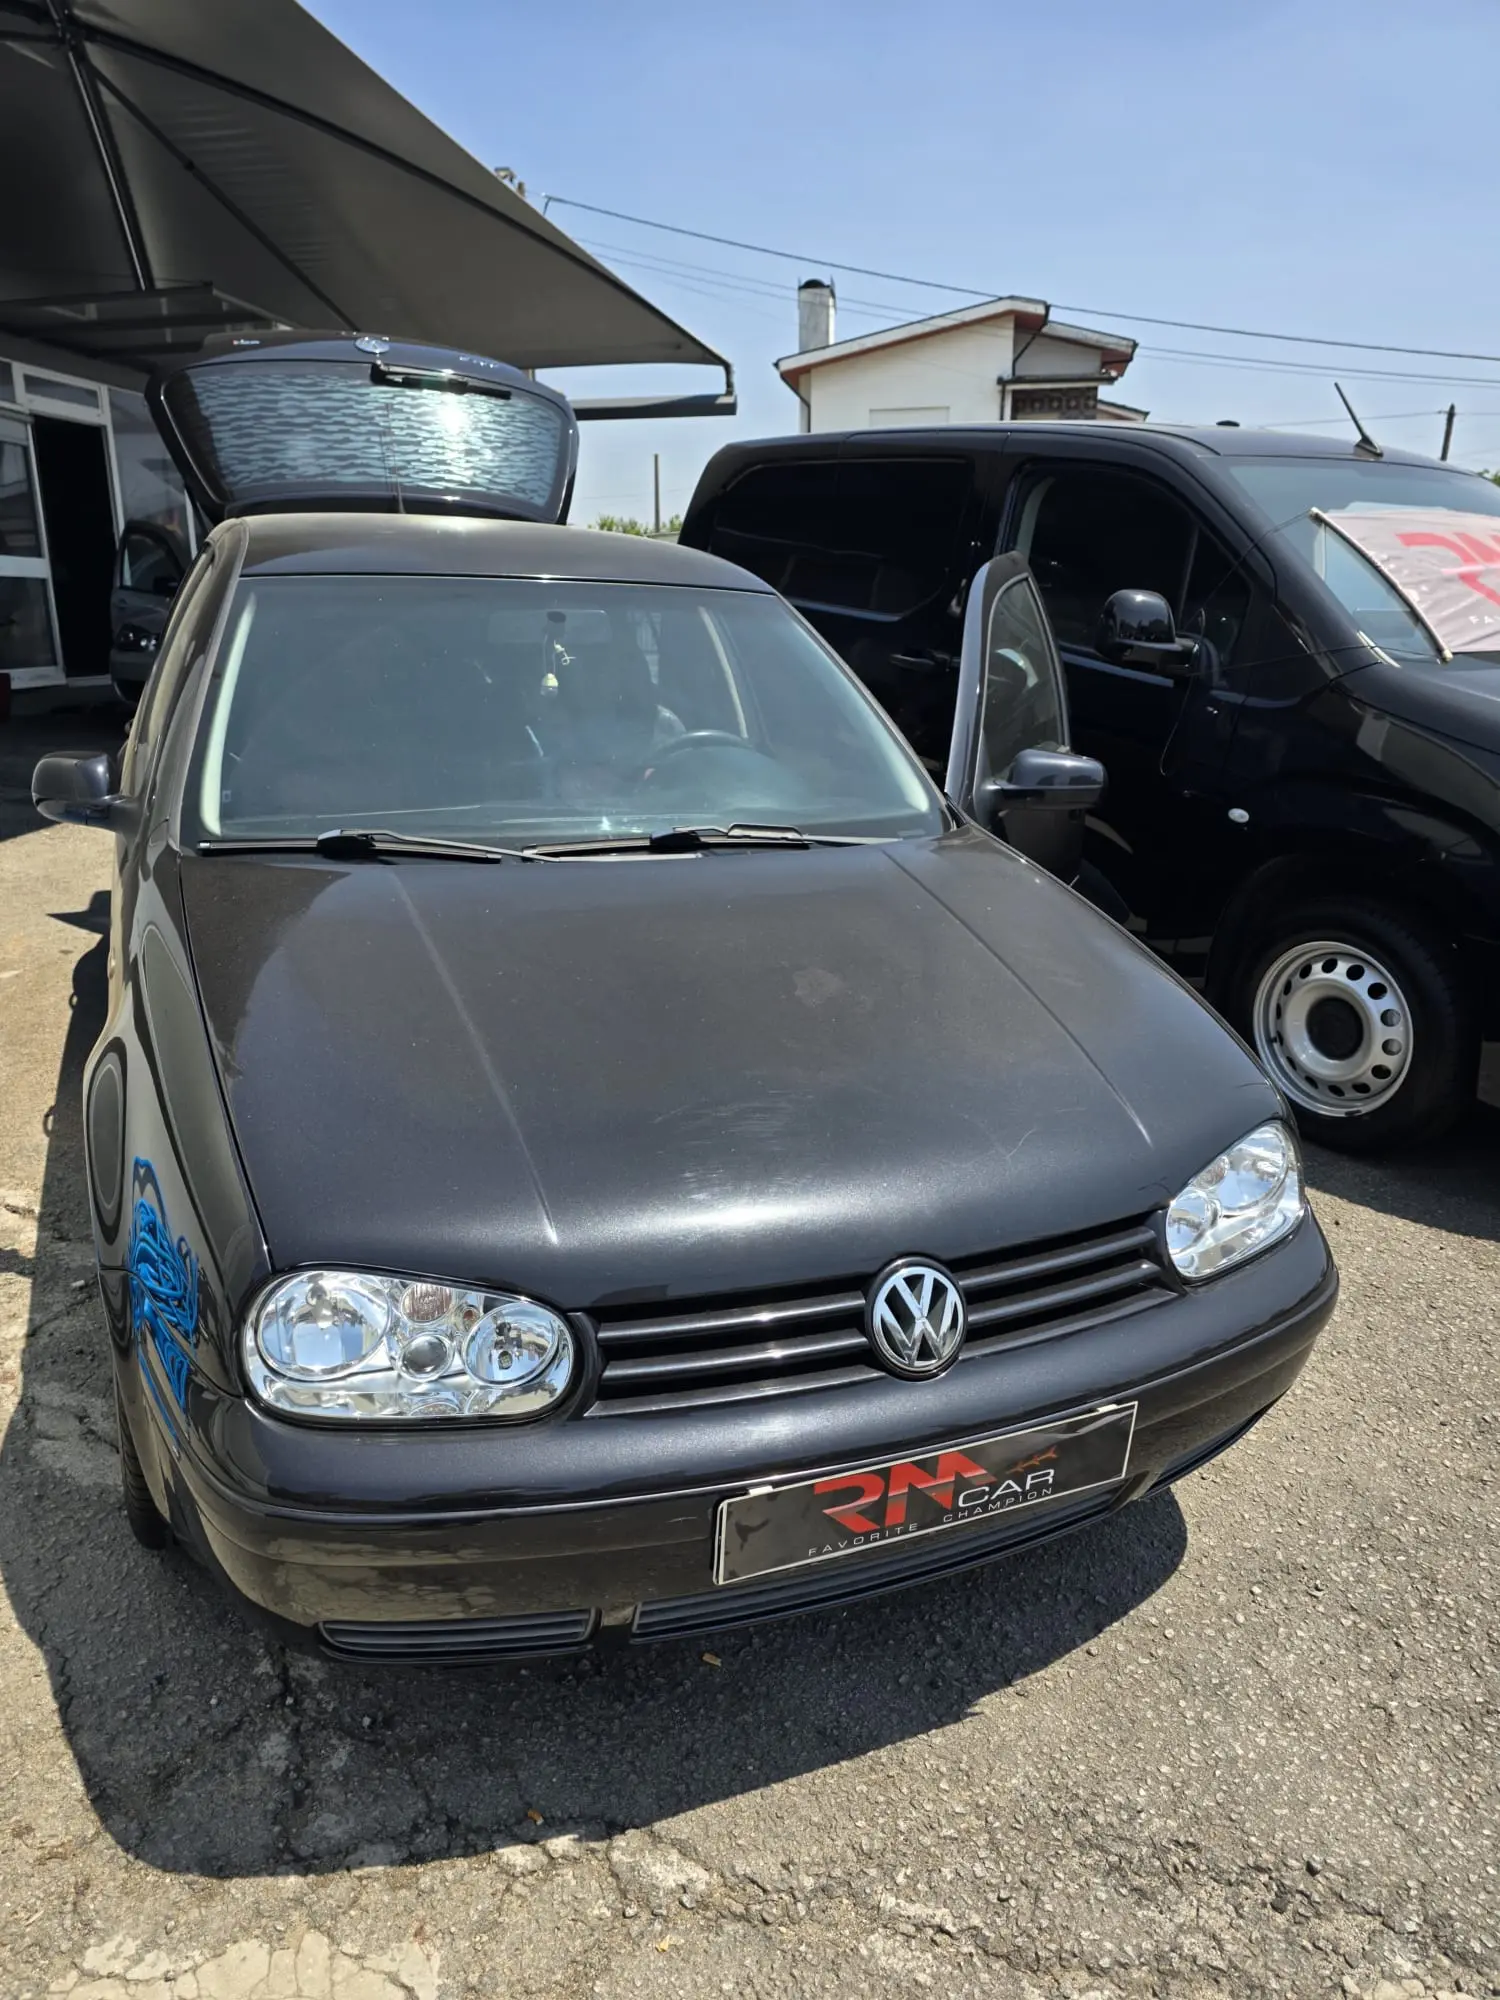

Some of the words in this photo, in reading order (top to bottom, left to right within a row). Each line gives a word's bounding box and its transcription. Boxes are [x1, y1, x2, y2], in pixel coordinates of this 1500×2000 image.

[808, 1522, 919, 1556] FAVORITE
[943, 1487, 1052, 1523] CHAMPION
[813, 1451, 998, 1534] RM
[958, 1469, 1055, 1508] CAR
